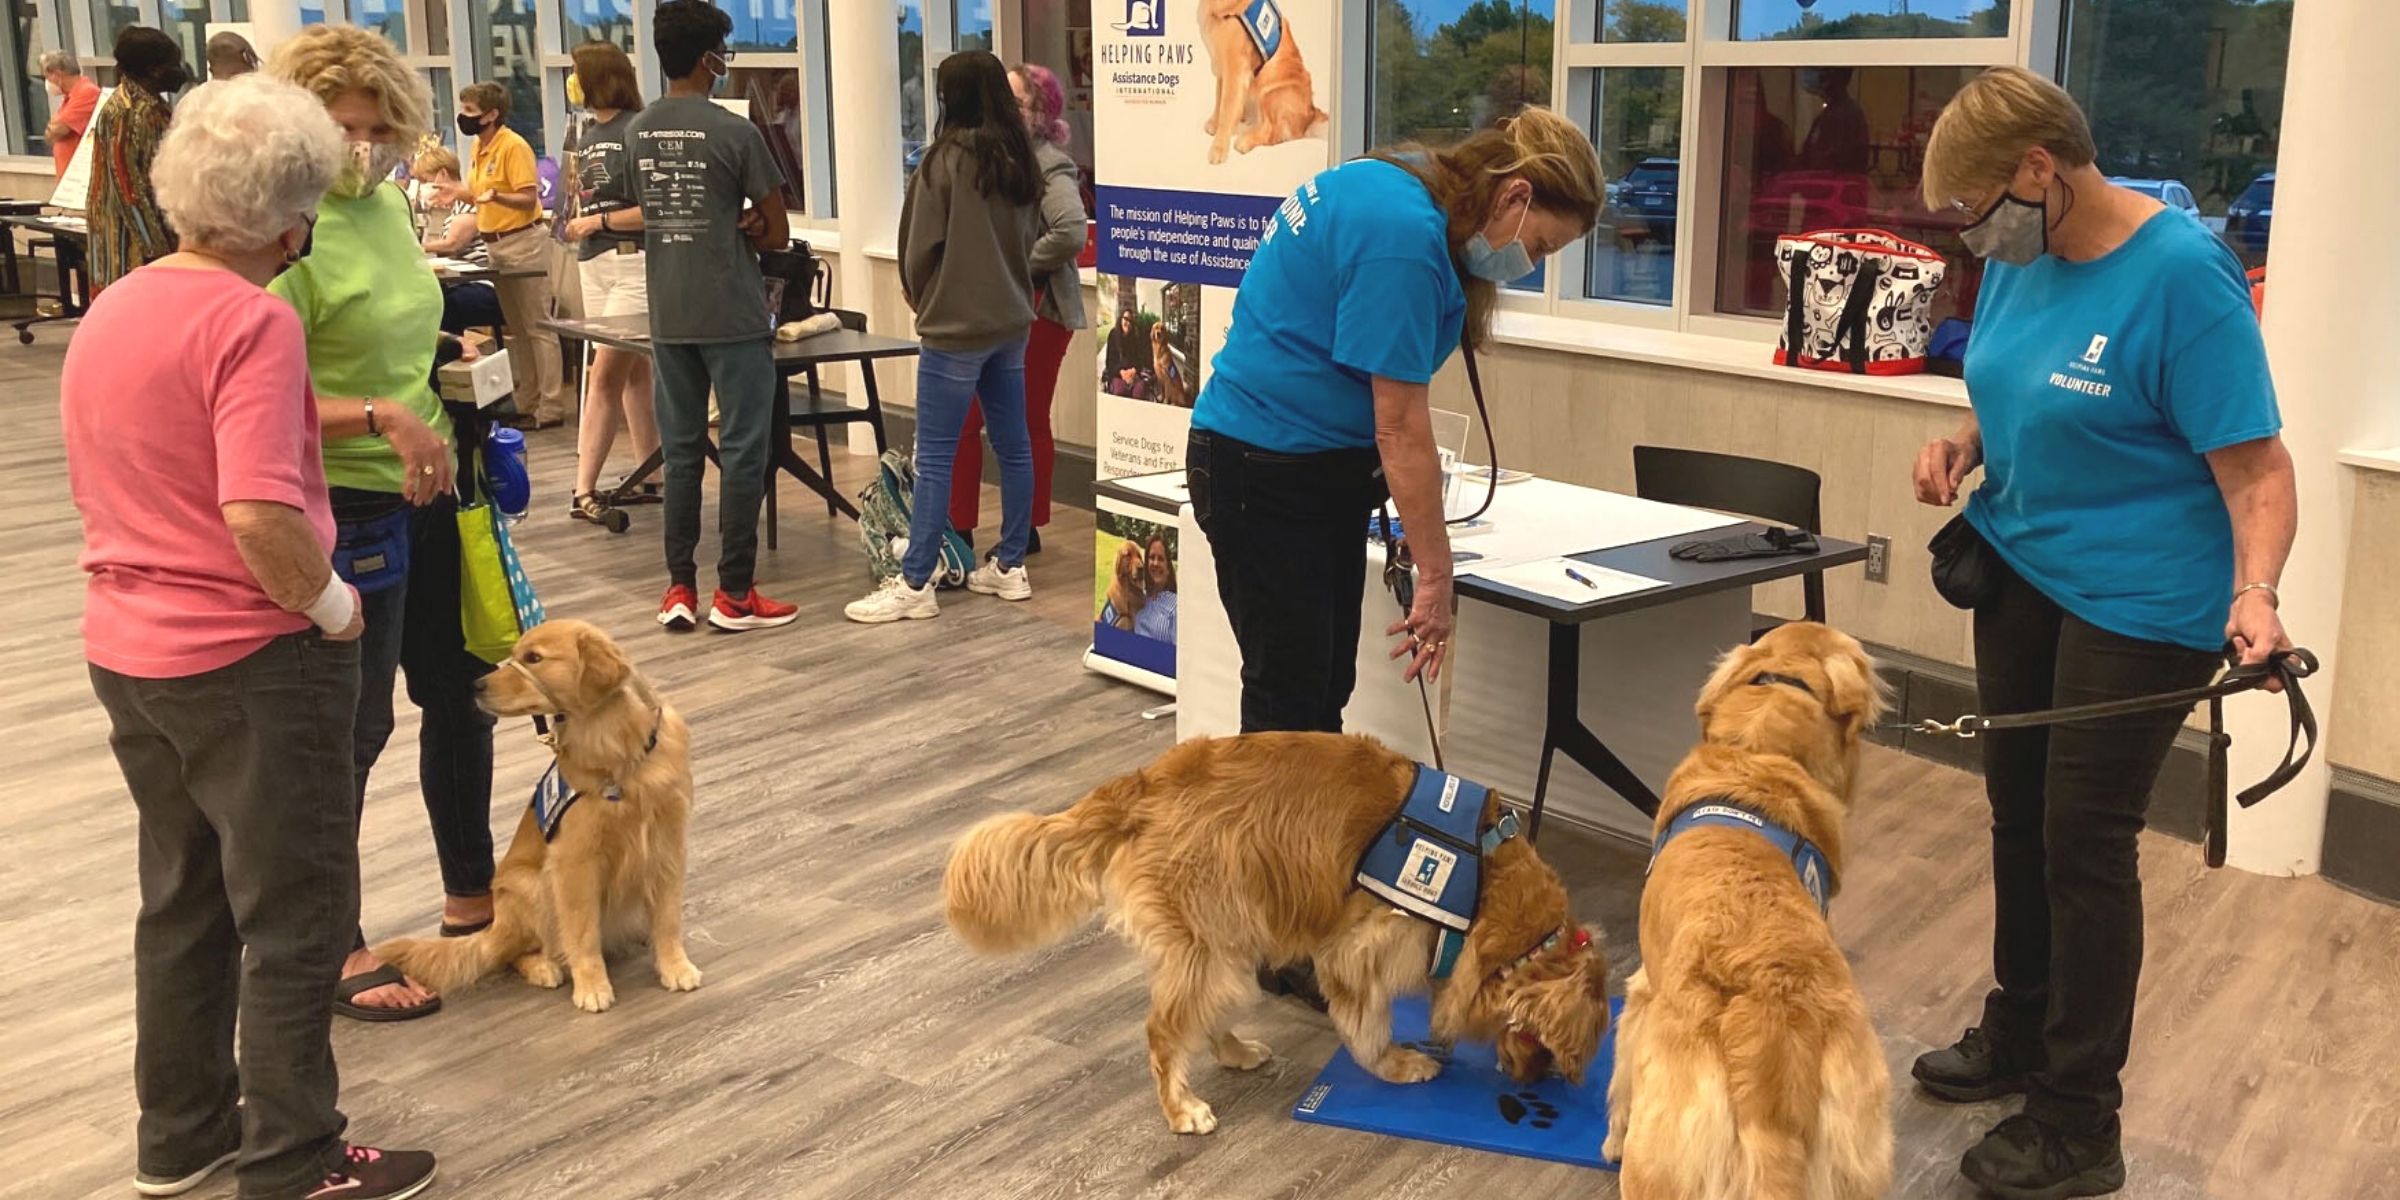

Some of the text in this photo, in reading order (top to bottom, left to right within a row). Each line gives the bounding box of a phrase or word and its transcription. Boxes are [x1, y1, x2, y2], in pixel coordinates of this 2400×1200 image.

[1101, 44, 1193, 64] HELPING PAWS
[1112, 71, 1180, 87] Assistance Dogs
[1115, 87, 1175, 95] INTERNATIONAL
[658, 140, 684, 150] CEM
[1109, 204, 1125, 219] The
[1126, 206, 1160, 222] mission
[1162, 208, 1173, 223] of
[1174, 209, 1209, 230] Helping
[1210, 212, 1236, 229] Paws
[1237, 213, 1247, 230] is
[1249, 216, 1259, 231] to
[1110, 225, 1145, 241] people's
[1147, 227, 1210, 247] independence
[1212, 233, 1230, 248] and
[1118, 244, 1251, 270] through the use of Assistance
[2049, 372, 2112, 397] VOLUNTEER
[1112, 431, 1174, 455] Service Dogs for
[1110, 447, 1177, 470] Veterans and First
